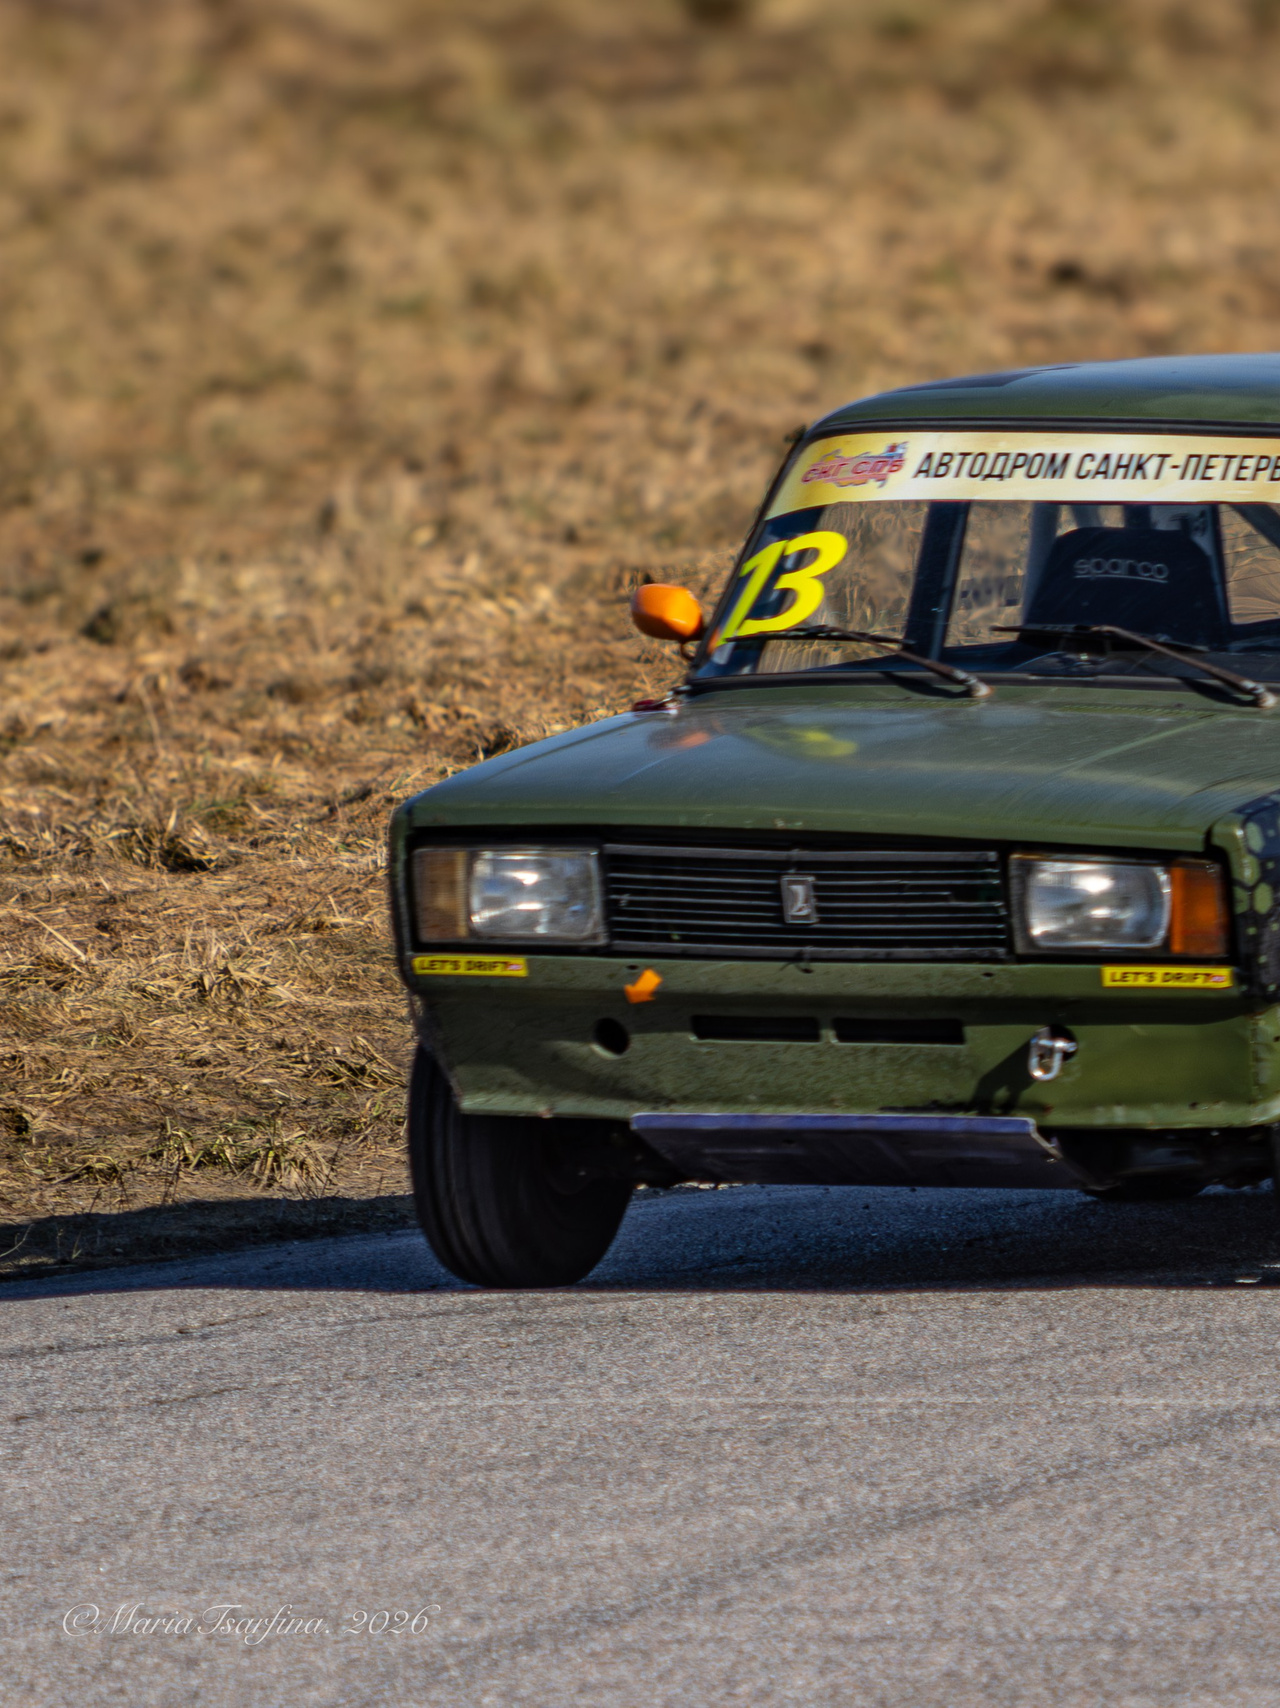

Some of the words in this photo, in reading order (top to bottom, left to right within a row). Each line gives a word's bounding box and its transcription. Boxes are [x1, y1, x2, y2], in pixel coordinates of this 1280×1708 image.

[912, 452, 1072, 482] АВТОДРОМ
[1073, 558, 1169, 580] sparco
[714, 530, 848, 648] 13
